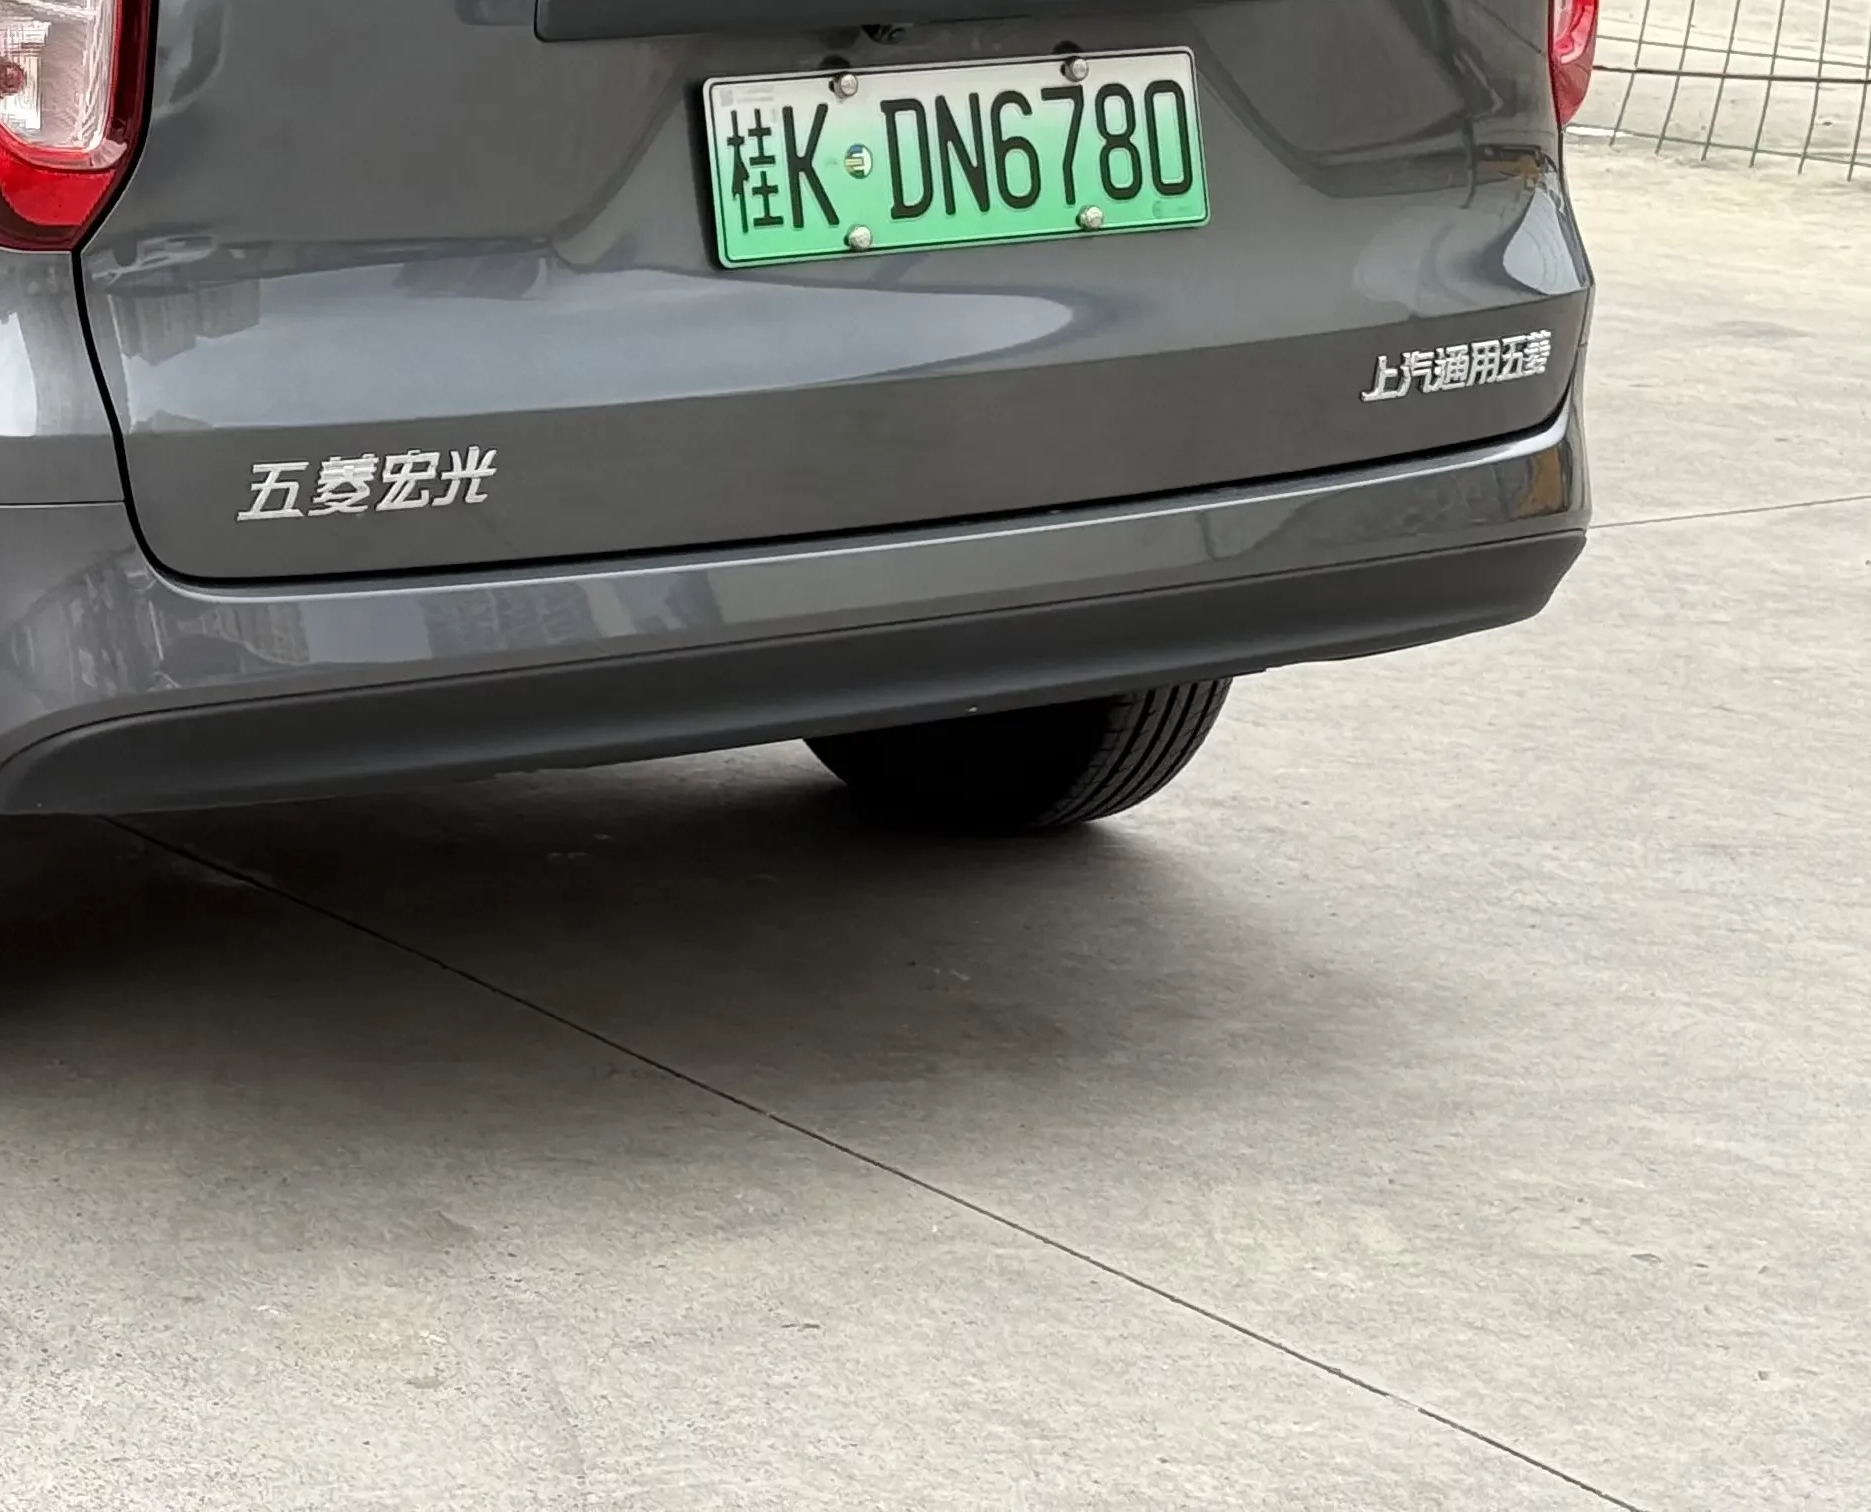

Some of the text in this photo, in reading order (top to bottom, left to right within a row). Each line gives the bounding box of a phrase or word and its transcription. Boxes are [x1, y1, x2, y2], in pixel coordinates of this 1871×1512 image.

[1359, 329, 1552, 402] 上汽通用五菱
[236, 445, 498, 522] 五菱宏光
